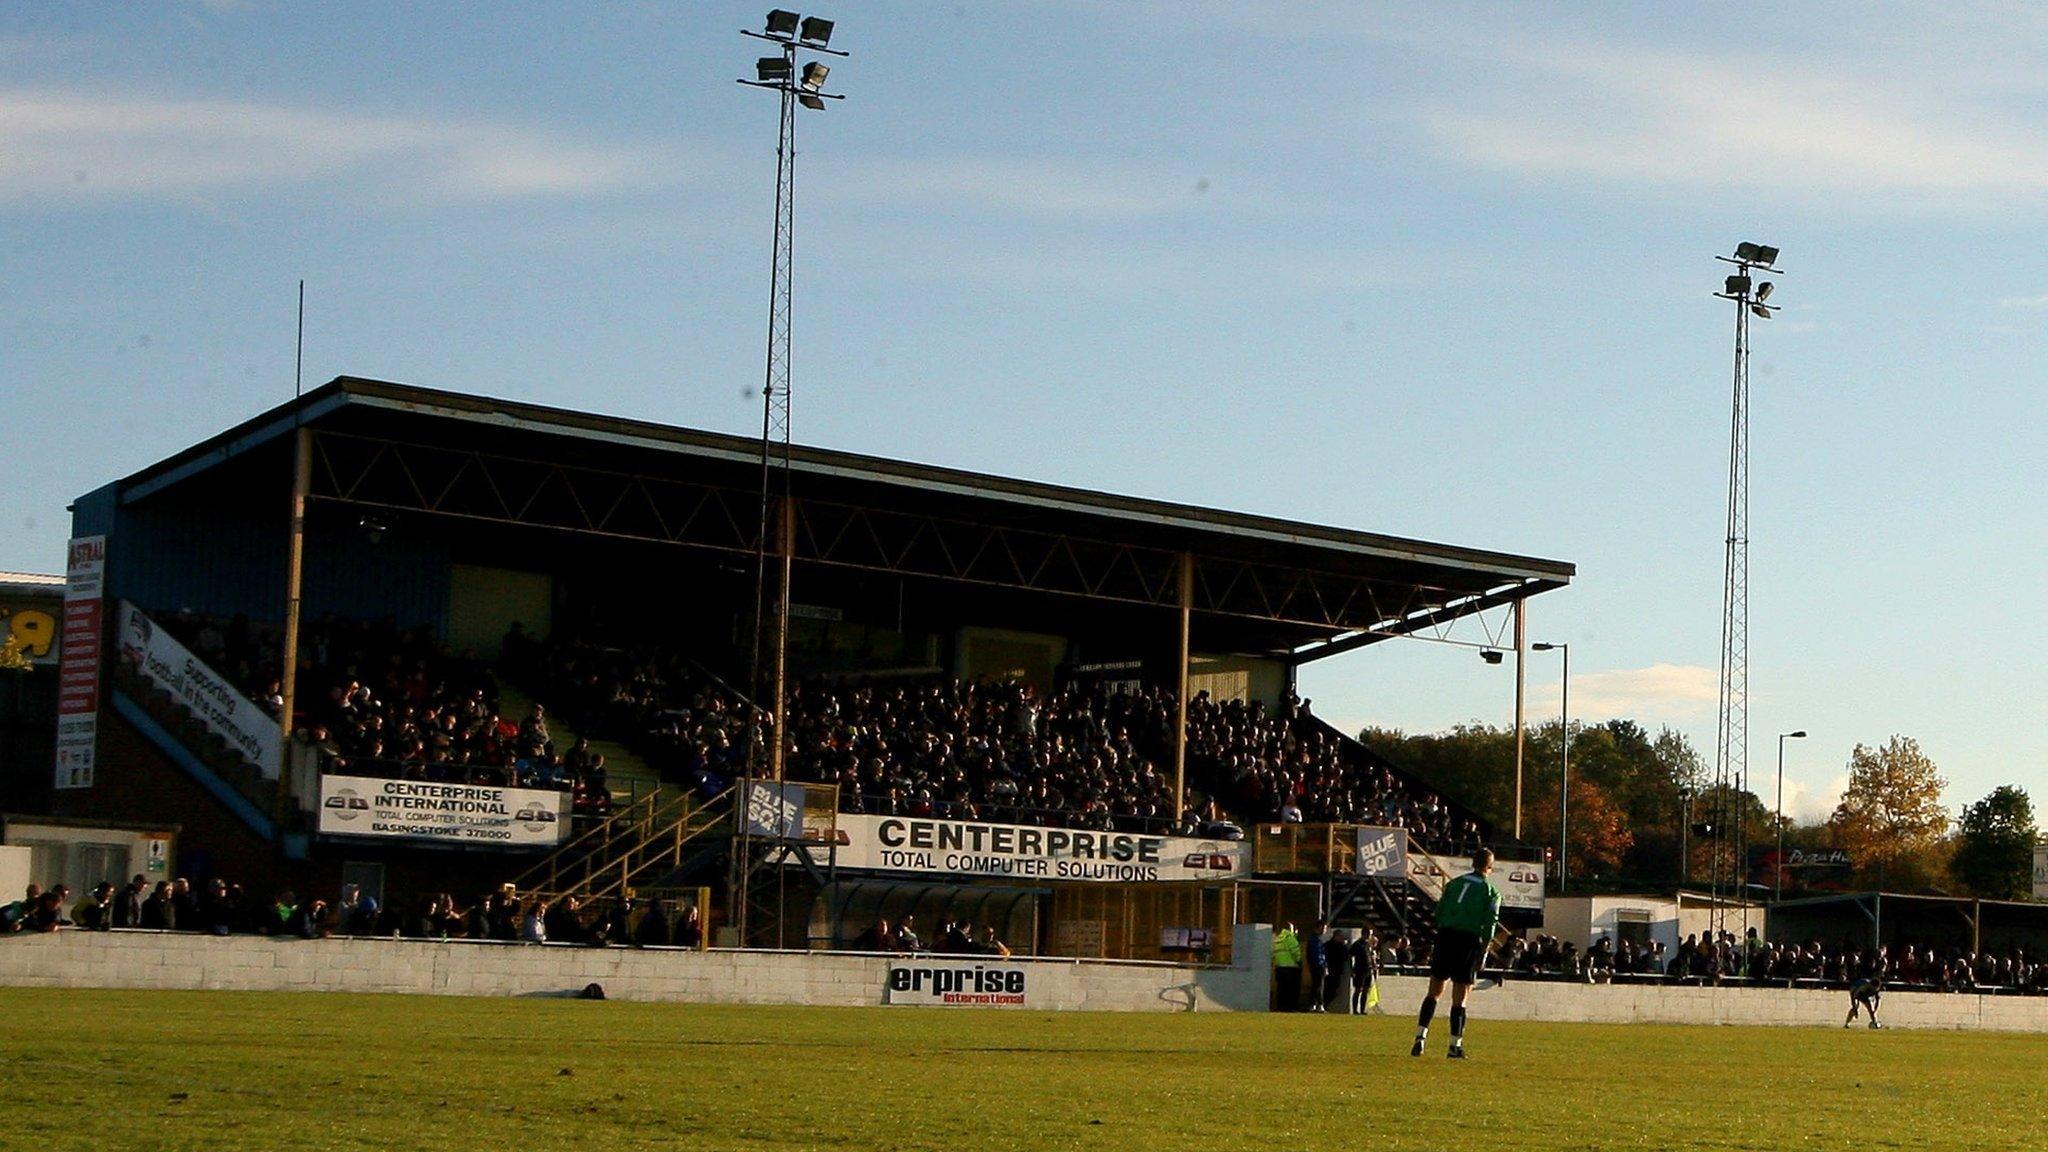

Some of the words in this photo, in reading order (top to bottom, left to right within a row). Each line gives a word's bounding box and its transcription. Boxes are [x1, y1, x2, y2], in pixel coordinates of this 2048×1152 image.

[184, 659, 236, 716] Supporting
[147, 652, 185, 693] football
[184, 681, 194, 701] in
[195, 690, 211, 715] the
[210, 708, 263, 760] community
[384, 782, 503, 802] CENTERPRISE
[375, 796, 510, 815] INTERNATIONAL
[372, 823, 460, 836] BASINGSTOKE
[376, 810, 402, 821] TOTAL
[405, 812, 456, 824] COMPUTER
[459, 815, 509, 827] SOLUTIONS
[878, 820, 1160, 863] CENTERPRISE
[1360, 833, 1397, 860] BLUE
[881, 850, 937, 869] TOTAL
[946, 855, 1048, 876] COMPUTER
[1057, 861, 1158, 881] SOLUTIONS
[1364, 857, 1388, 876] SQ
[1457, 882, 1471, 904] 1
[890, 966, 1025, 996] erprise
